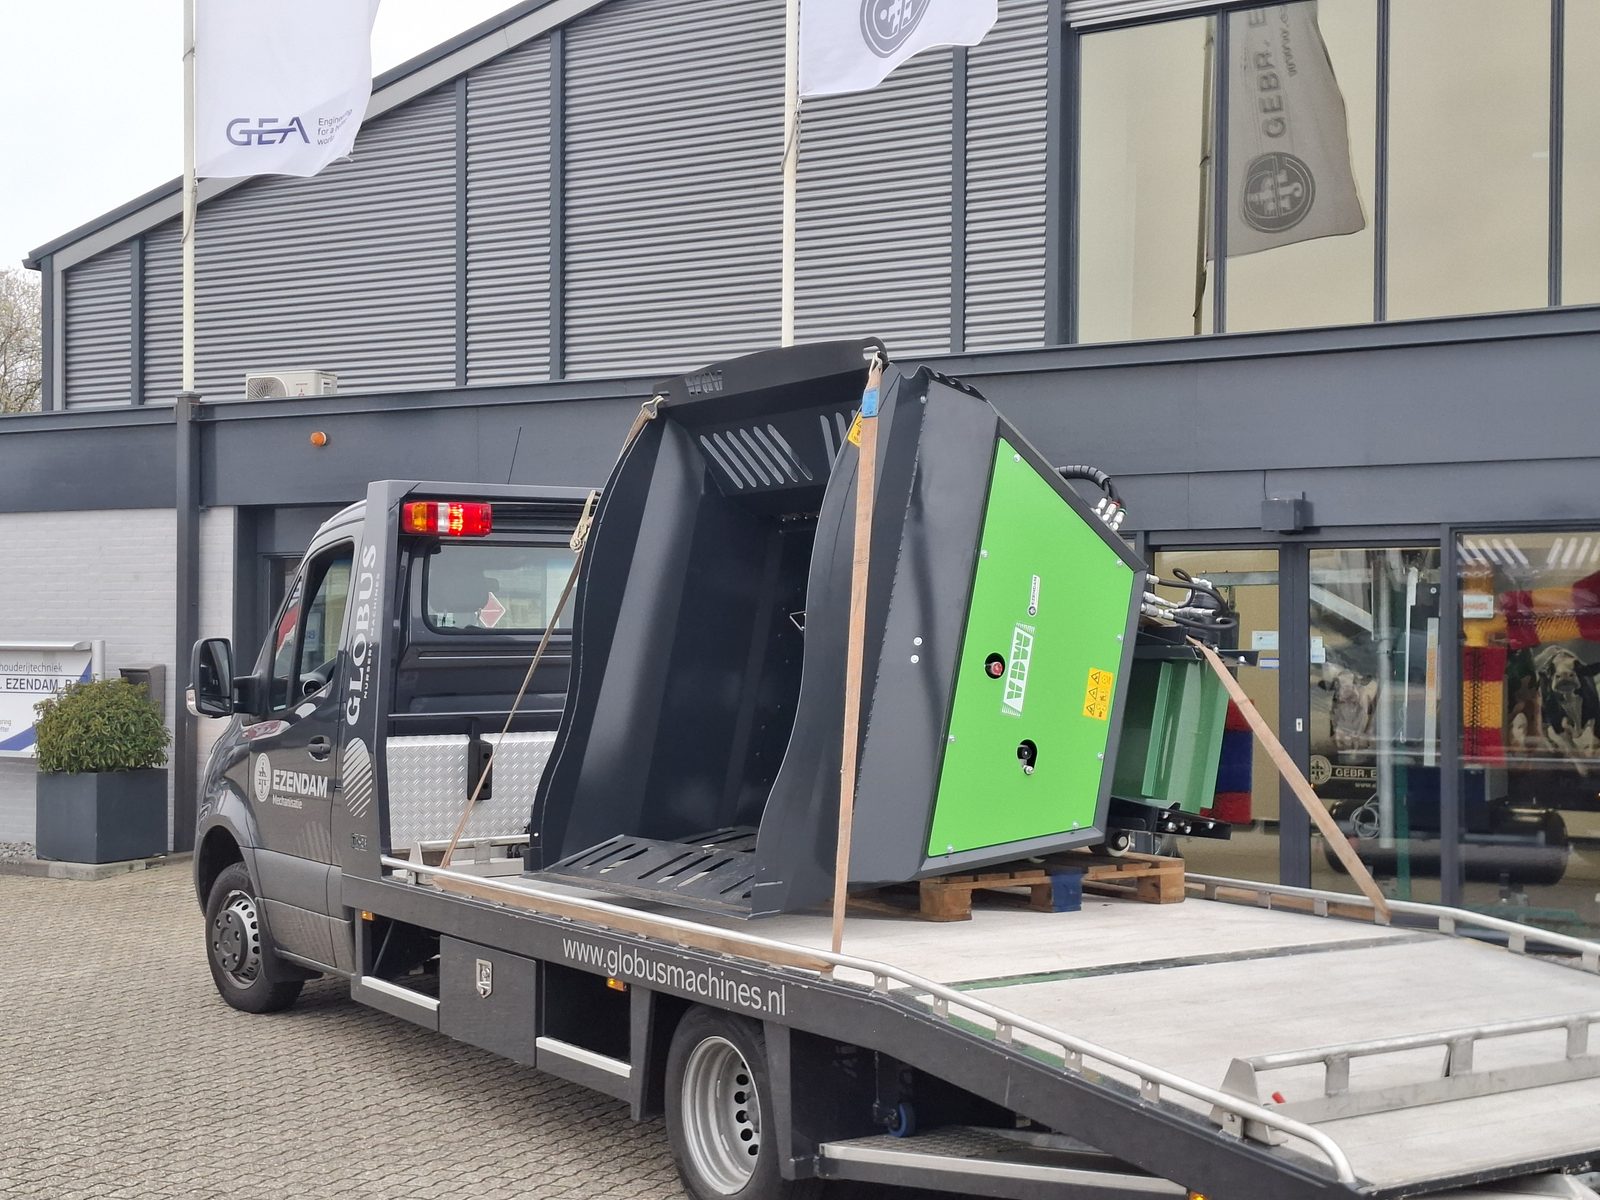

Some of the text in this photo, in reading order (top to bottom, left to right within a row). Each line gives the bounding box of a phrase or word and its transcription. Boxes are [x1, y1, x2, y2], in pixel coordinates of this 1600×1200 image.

[226, 116, 310, 146] GEA
[346, 544, 376, 726] GLOBUS
[6, 678, 59, 691] EZENDAM
[363, 642, 374, 698] NURSERY
[272, 769, 328, 798] EZENDAM
[1336, 768, 1367, 778] GEBR.
[562, 938, 786, 1016] www.globusmachines.nl
